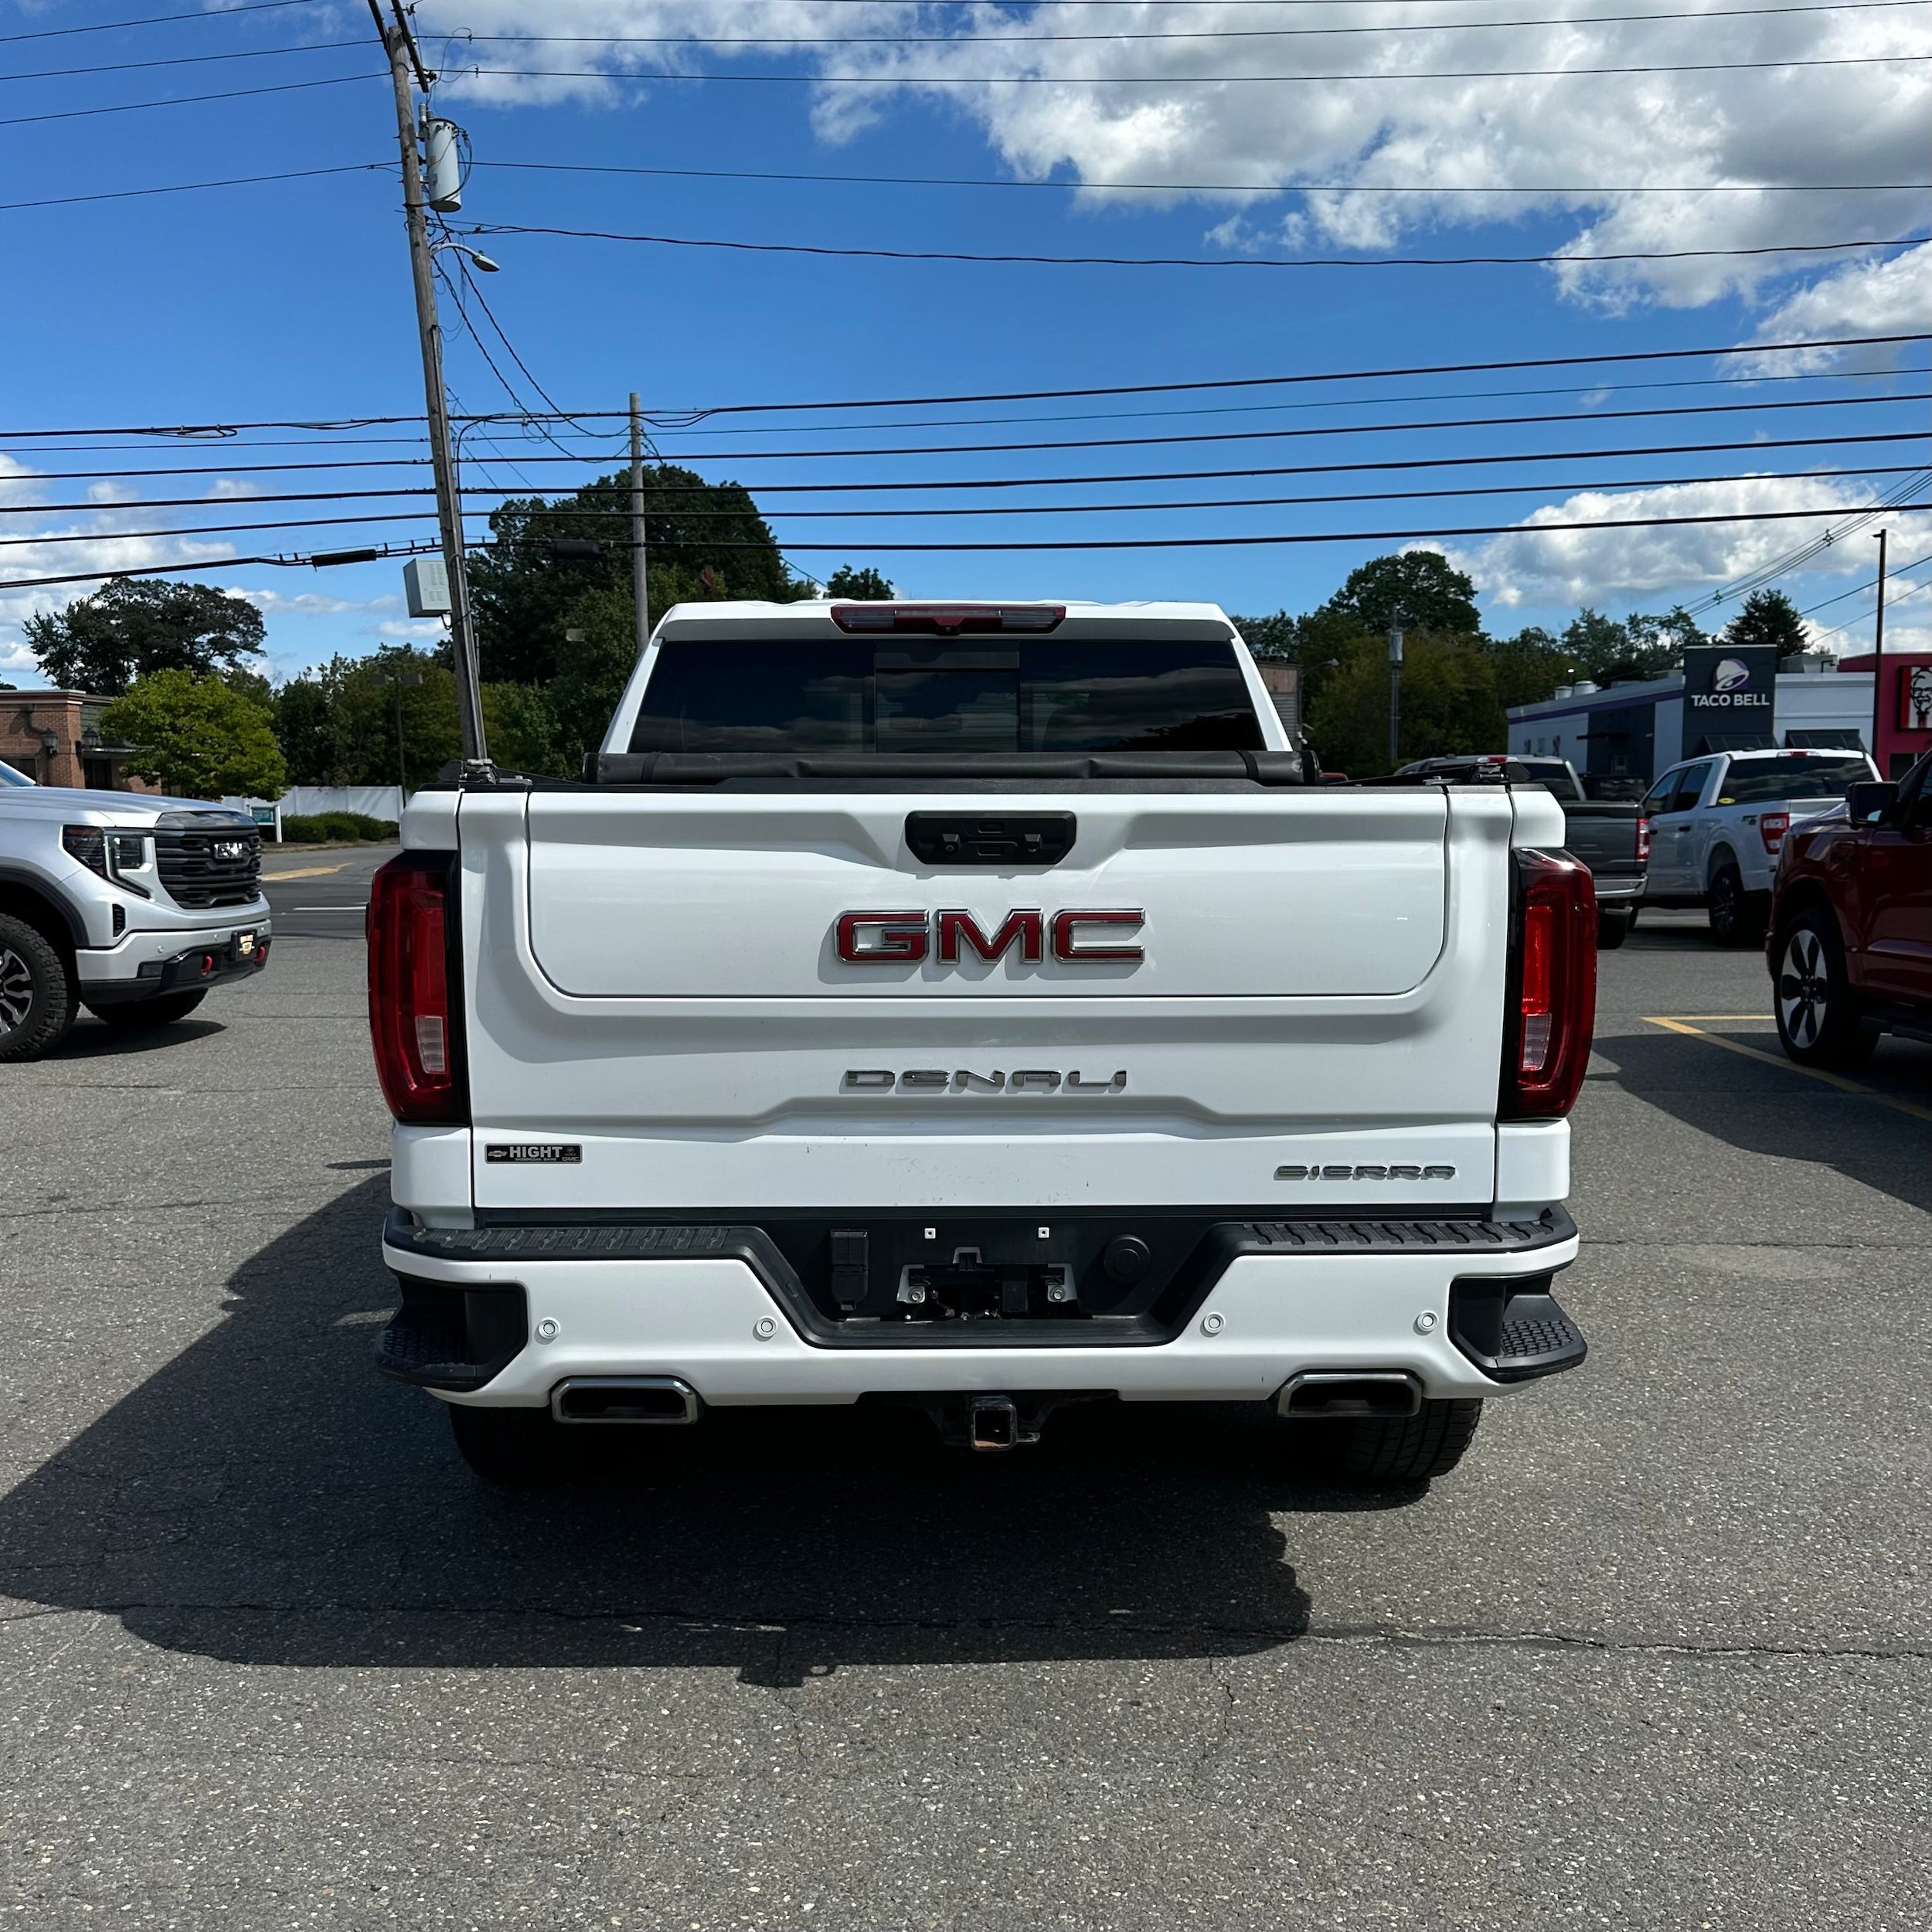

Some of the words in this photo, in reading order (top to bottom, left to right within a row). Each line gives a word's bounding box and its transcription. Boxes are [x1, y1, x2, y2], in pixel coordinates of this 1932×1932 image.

[1691, 694, 1731, 707] TACO
[1733, 693, 1770, 706] BELL
[835, 908, 1146, 964] GMC
[845, 1069, 1128, 1087] DENALI
[509, 1146, 563, 1158] HIGHT
[1276, 1165, 1457, 1179] SIERRA
